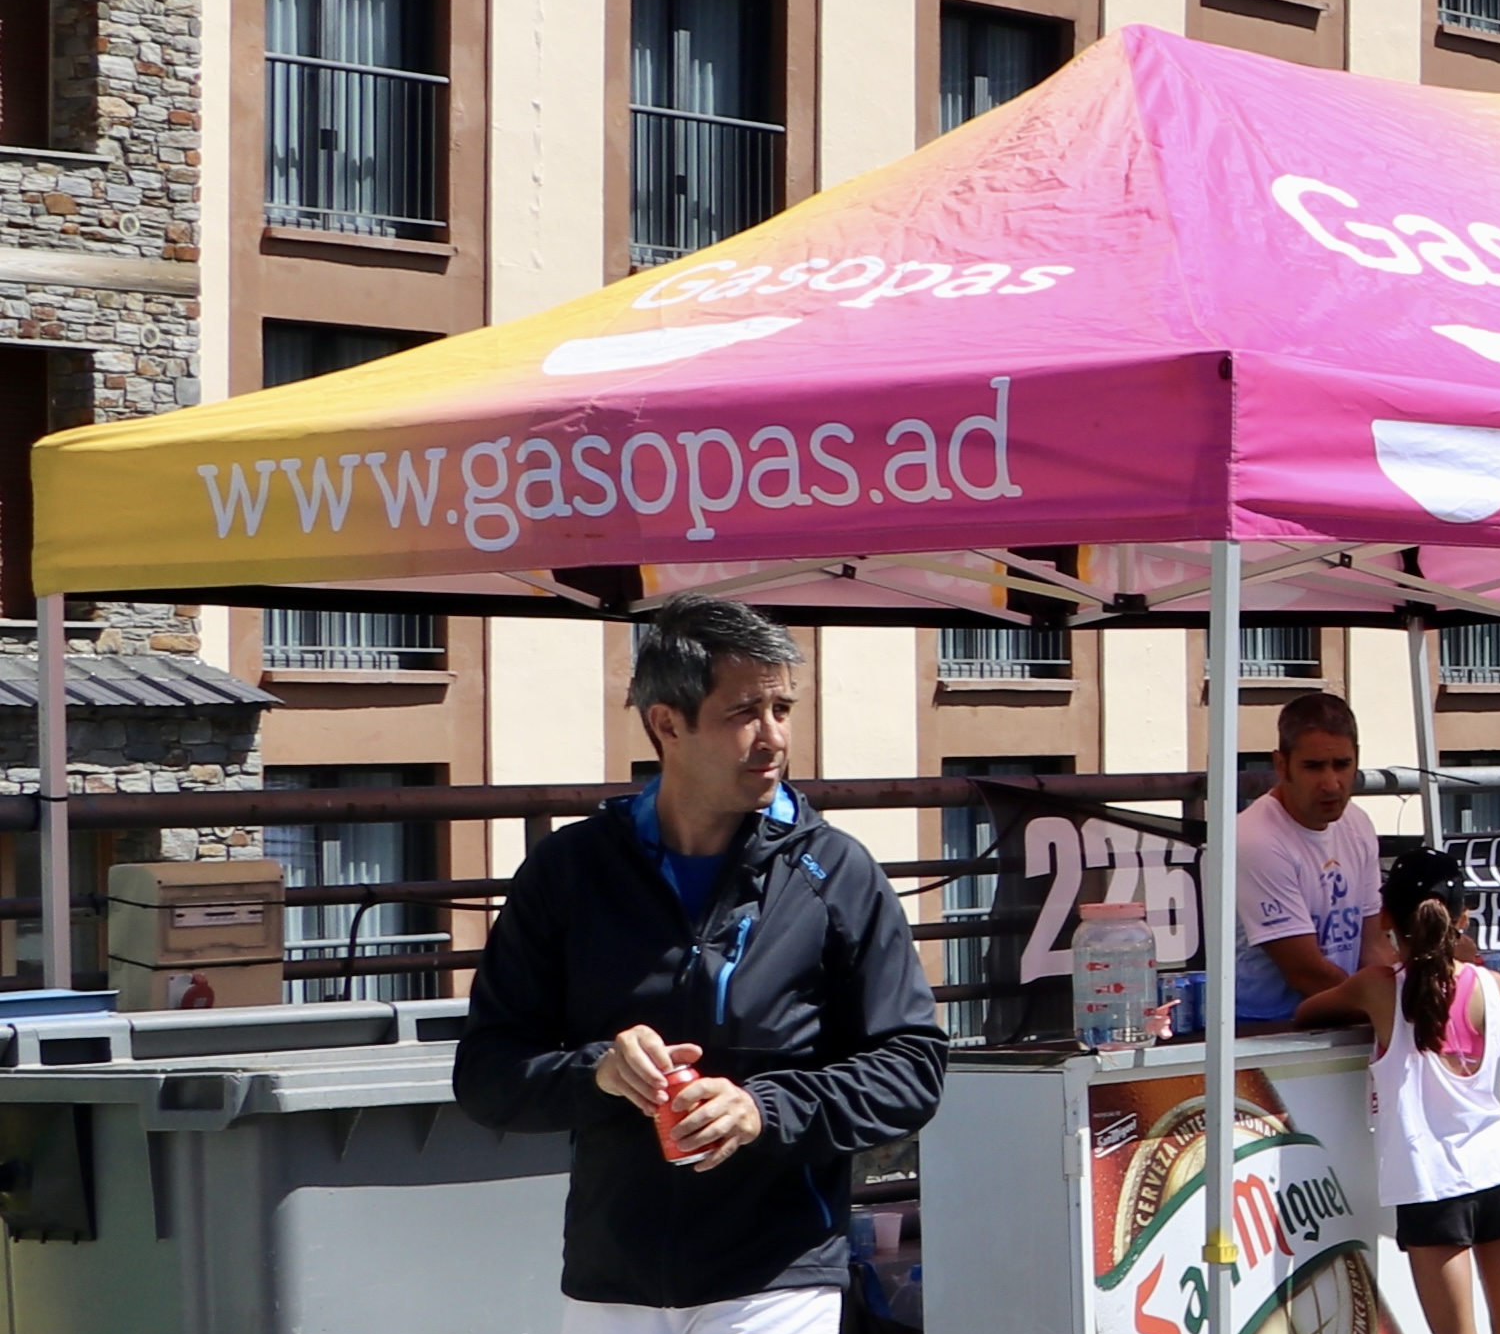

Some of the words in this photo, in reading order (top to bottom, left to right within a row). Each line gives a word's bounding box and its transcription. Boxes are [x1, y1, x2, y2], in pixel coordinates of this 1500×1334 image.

[631, 255, 1075, 314] Gasopas
[199, 376, 1021, 554] www.gasopas.ad
[1136, 1141, 1178, 1228] CERVEZA
